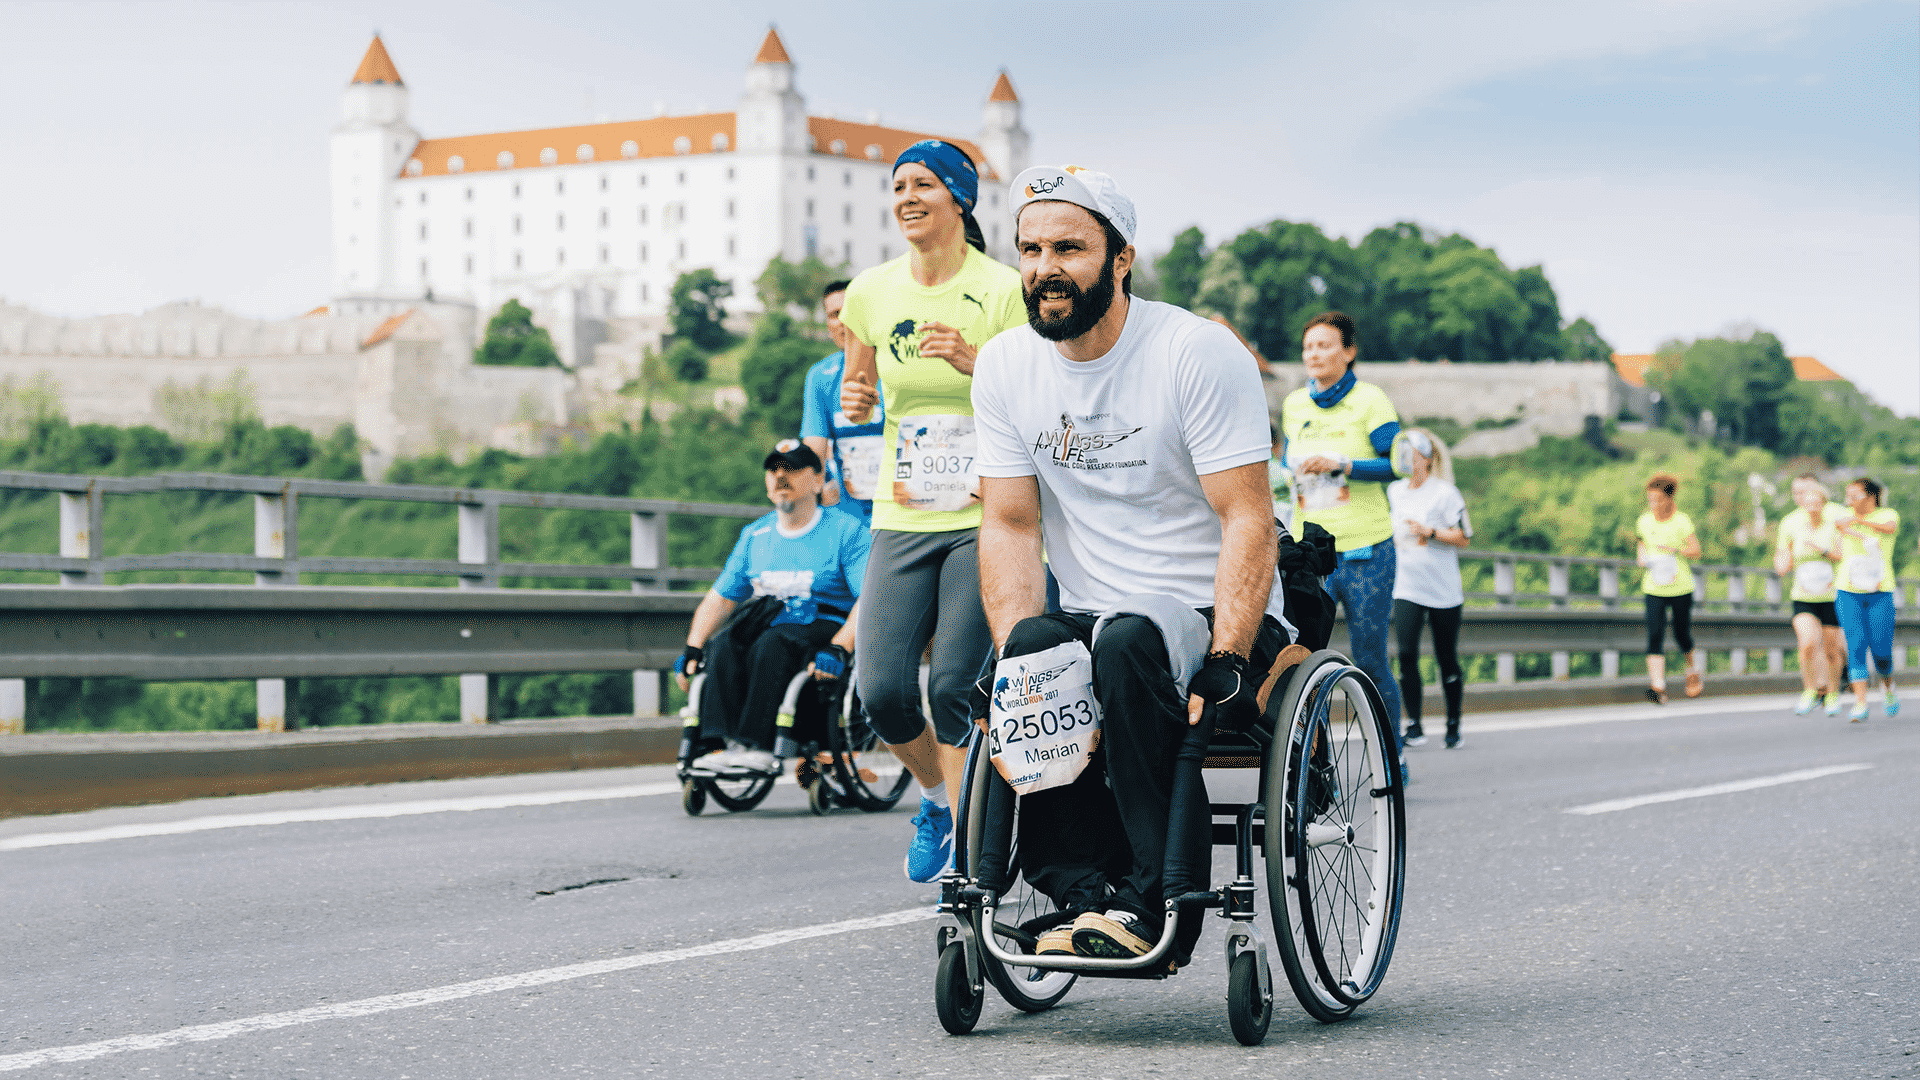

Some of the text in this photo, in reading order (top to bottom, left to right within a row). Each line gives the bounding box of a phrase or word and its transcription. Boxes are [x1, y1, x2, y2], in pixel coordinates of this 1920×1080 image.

[1045, 429, 1105, 451] WINGS
[1052, 446, 1086, 462] LIFE
[922, 455, 974, 475] 9037
[1053, 459, 1071, 468] SPINAL
[1086, 461, 1114, 471] RESEARCH
[923, 480, 968, 493] Daniela
[1011, 670, 1053, 689] WINGS
[1019, 682, 1043, 697] LIFE
[1044, 689, 1060, 701] 2017
[1003, 700, 1094, 745] 25053
[1024, 742, 1081, 764] Marian
